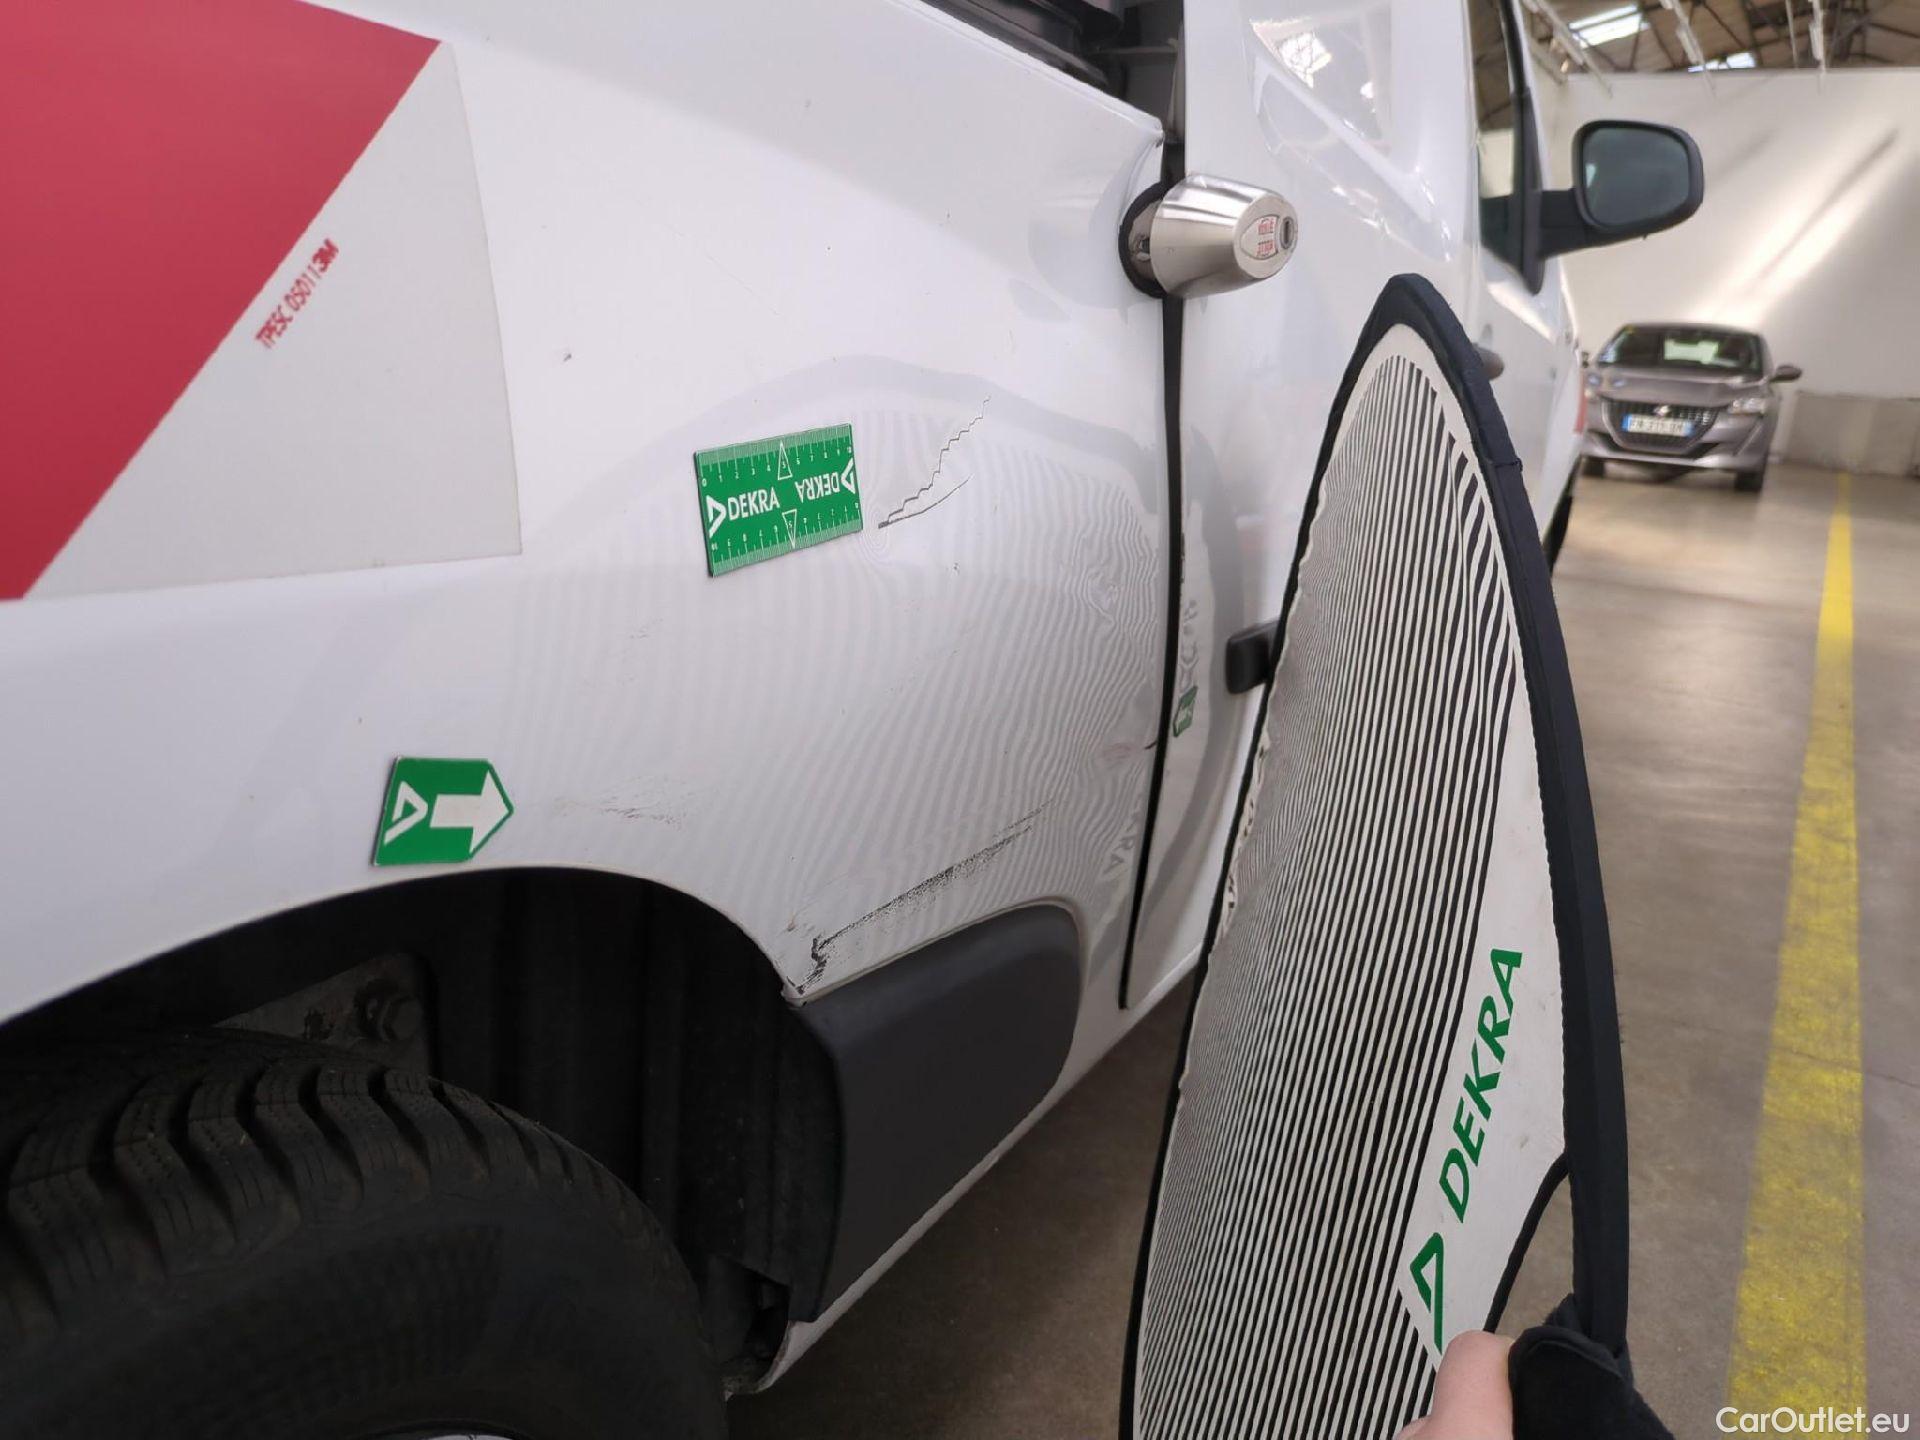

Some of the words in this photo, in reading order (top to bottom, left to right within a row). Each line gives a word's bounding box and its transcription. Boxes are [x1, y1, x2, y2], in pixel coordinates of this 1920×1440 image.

[727, 486, 780, 521] DEKRA
[794, 471, 841, 503] DEKRA
[1438, 947, 1522, 1224] DEKRA
